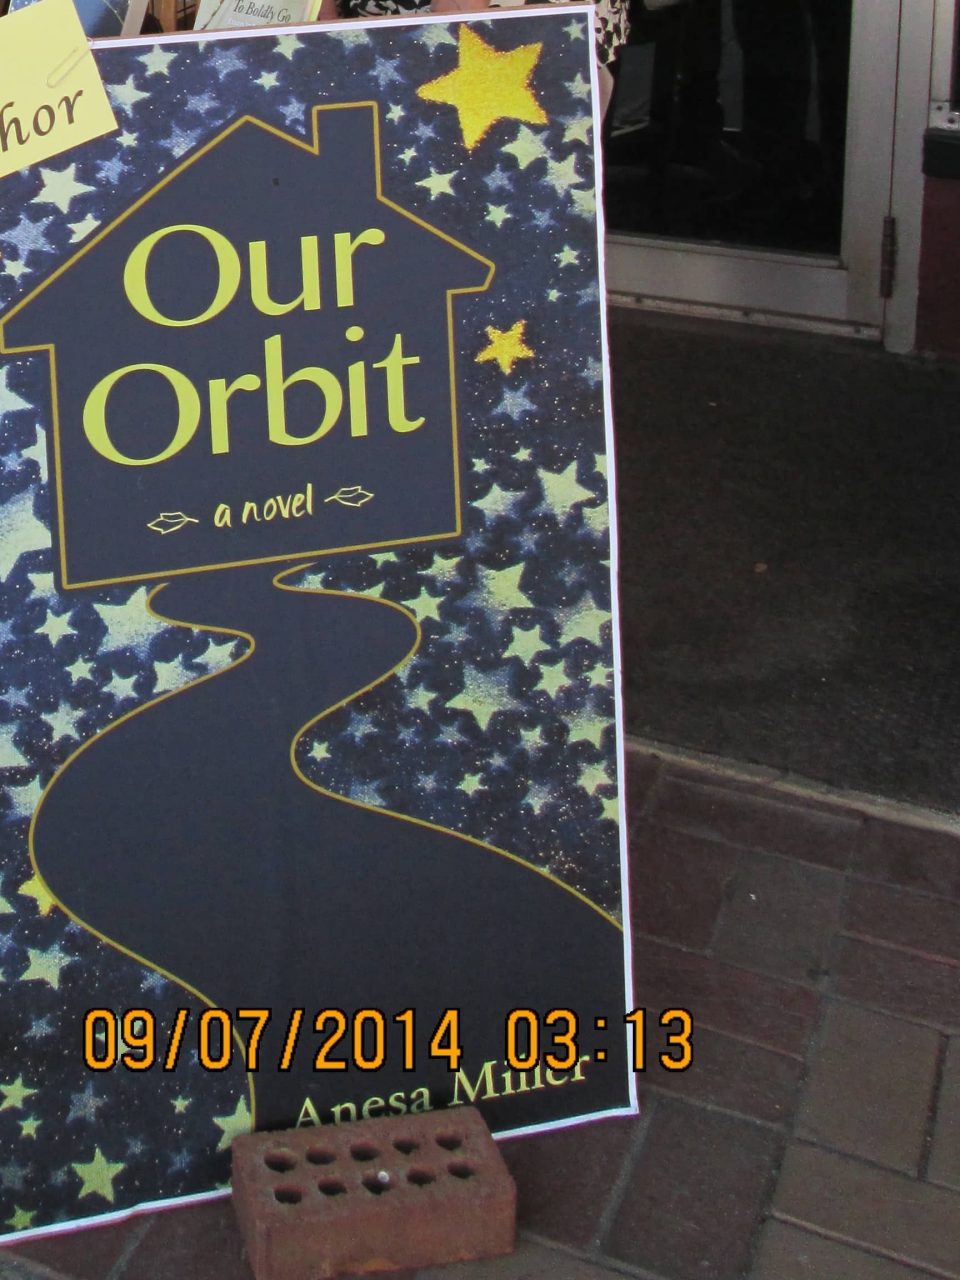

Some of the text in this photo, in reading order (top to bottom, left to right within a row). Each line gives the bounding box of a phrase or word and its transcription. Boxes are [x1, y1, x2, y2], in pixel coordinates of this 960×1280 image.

[245, 1, 275, 24] Boldly
[276, 7, 292, 23] Go
[123, 223, 386, 328] Our
[82, 325, 426, 466] Orbit
[213, 483, 314, 528] a novel
[295, 1086, 431, 1128] Anesa
